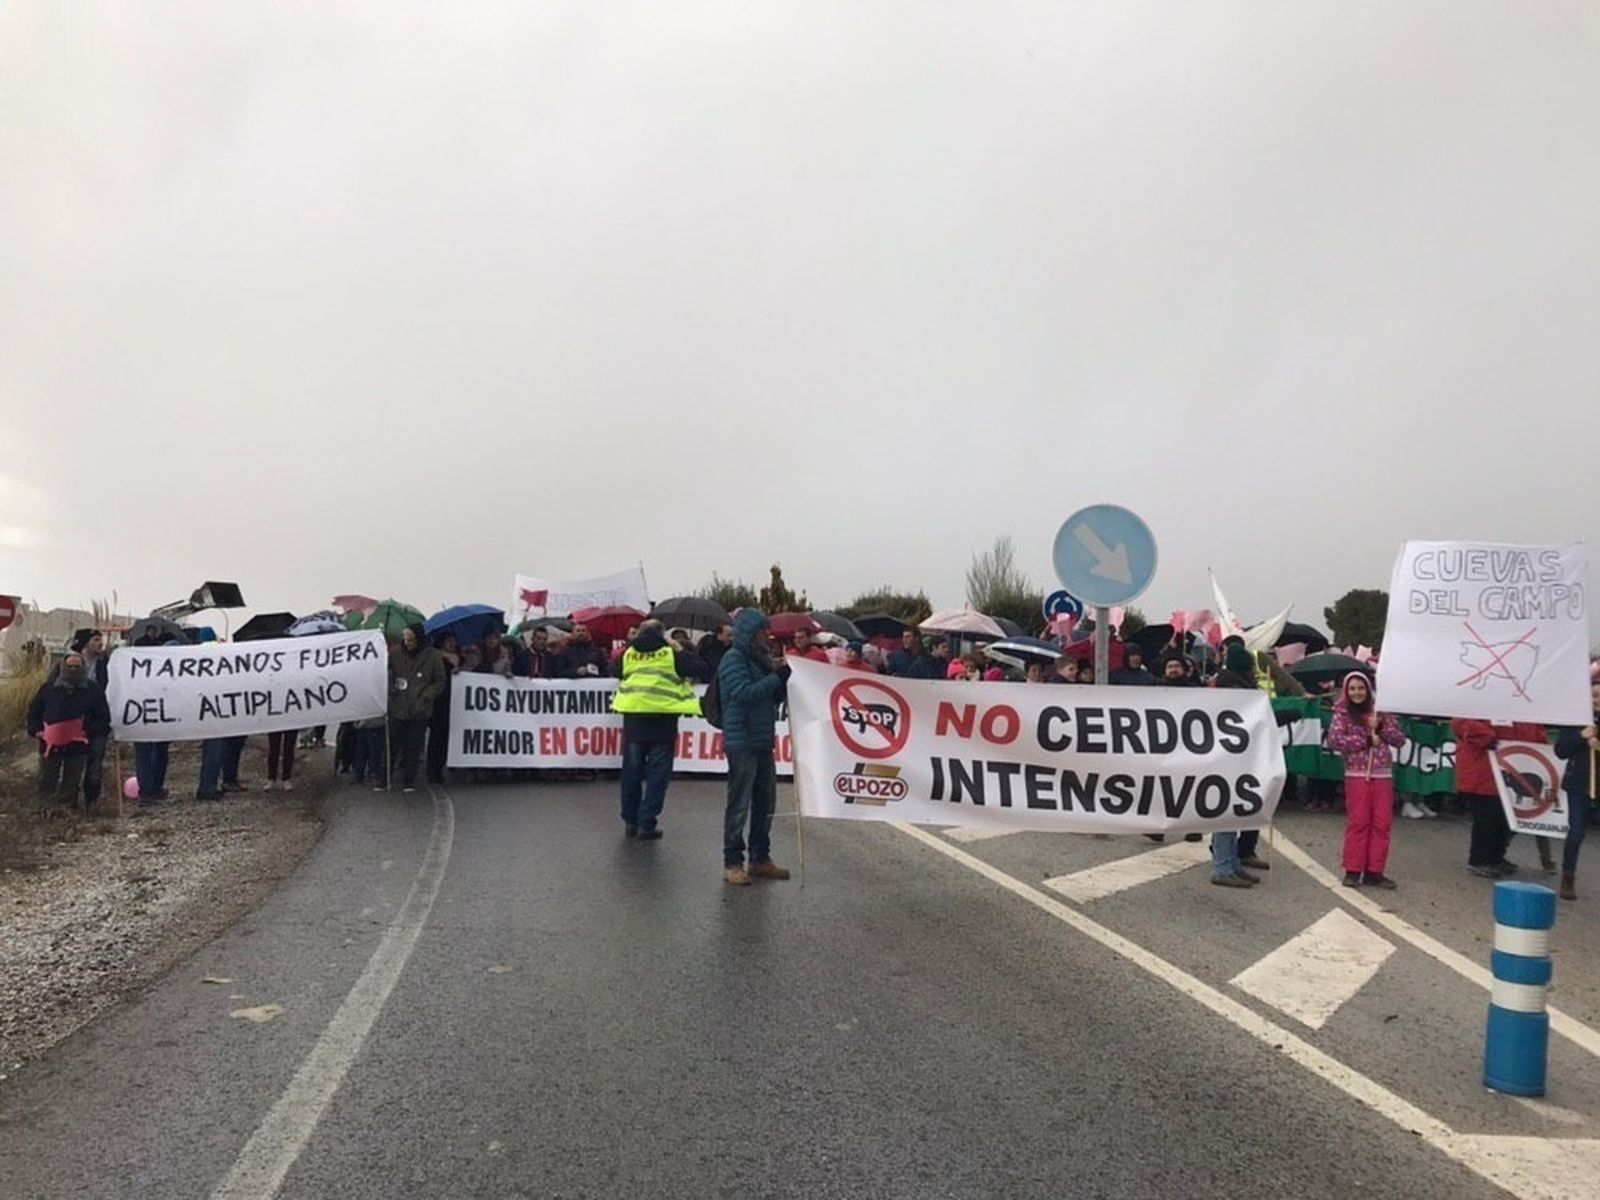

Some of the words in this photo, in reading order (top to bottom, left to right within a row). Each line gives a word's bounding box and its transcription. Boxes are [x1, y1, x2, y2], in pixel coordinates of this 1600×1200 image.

[1413, 550, 1564, 583] CUEVAS
[1409, 589, 1470, 617] DEL
[1478, 582, 1584, 621] CAMPO
[131, 652, 286, 679] MARRANOS
[299, 641, 378, 670] FUERA
[199, 680, 348, 721] ALTIPLANO
[464, 685, 500, 712] LOS
[505, 689, 618, 714] AYUNTAMIE
[847, 707, 895, 727] STOP
[462, 729, 534, 755] MENOR
[539, 727, 567, 756] EN
[699, 731, 726, 760] LA
[935, 701, 1021, 745] NO
[1037, 705, 1250, 755] CERDOS
[930, 757, 1264, 820] INTENSIVOS
